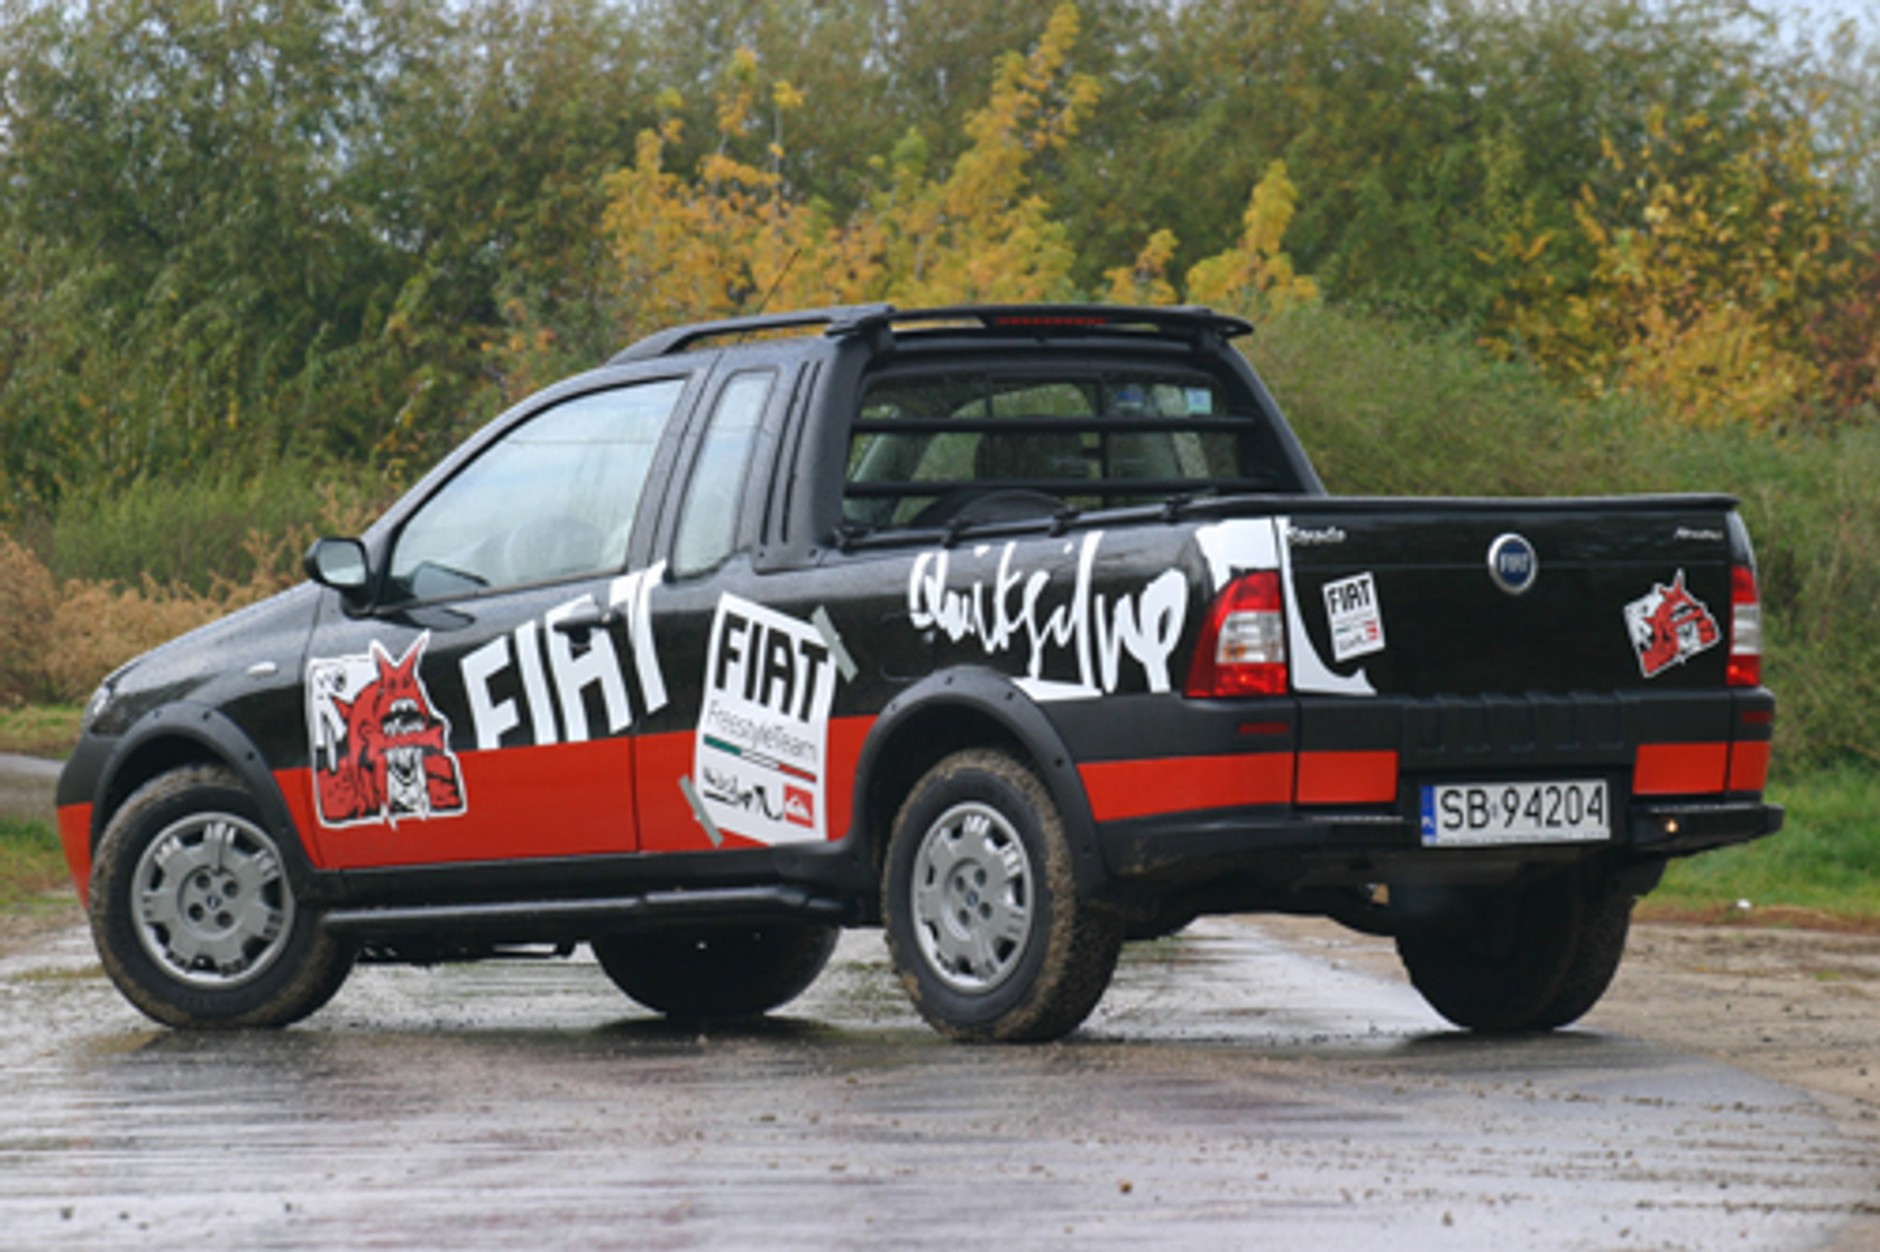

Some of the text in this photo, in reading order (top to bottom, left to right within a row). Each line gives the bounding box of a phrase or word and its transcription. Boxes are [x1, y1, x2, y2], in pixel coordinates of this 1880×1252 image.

[1327, 579, 1370, 614] FIAT
[459, 558, 668, 750] FIAT
[714, 610, 828, 723] FIAT
